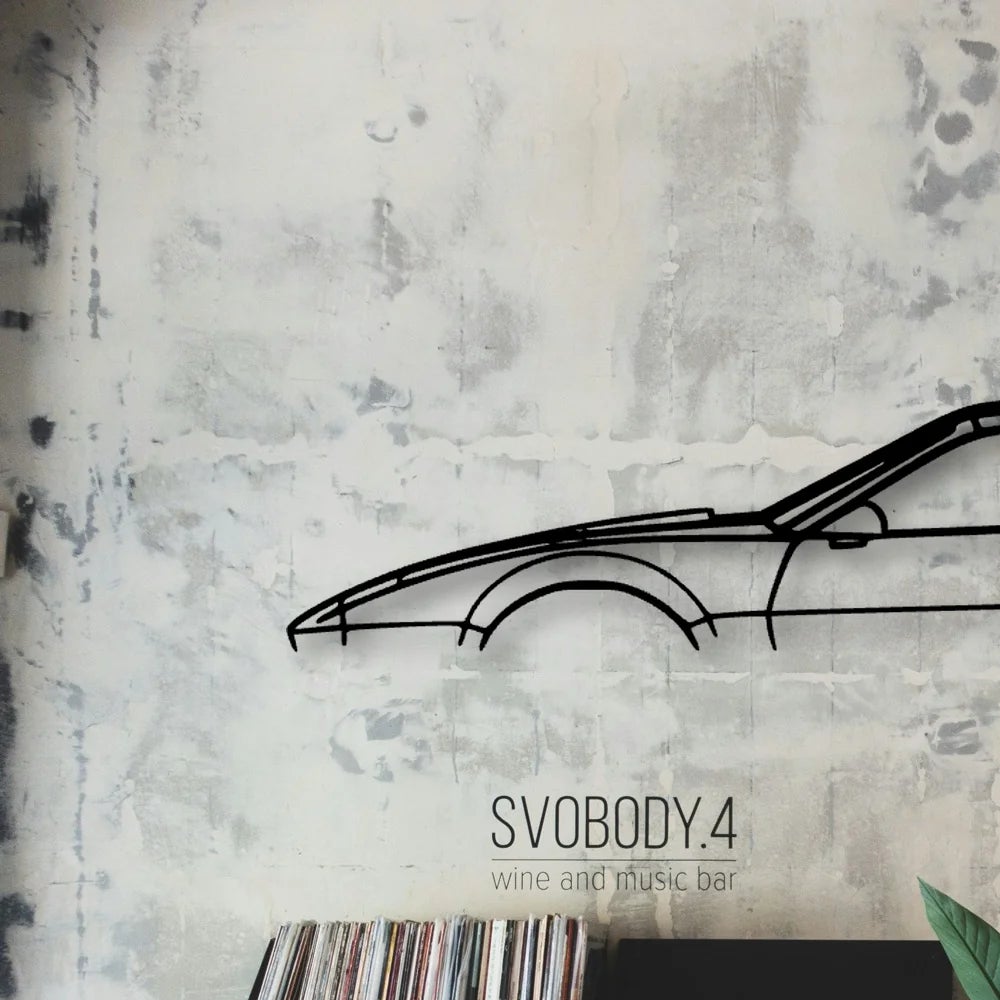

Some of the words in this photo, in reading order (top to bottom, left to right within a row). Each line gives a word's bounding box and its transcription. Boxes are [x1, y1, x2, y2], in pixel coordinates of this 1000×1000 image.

[491, 795, 738, 849] SVOBODY.4
[491, 867, 550, 891] wine
[560, 866, 605, 891] and
[616, 867, 687, 891] music
[697, 866, 737, 891] bar
